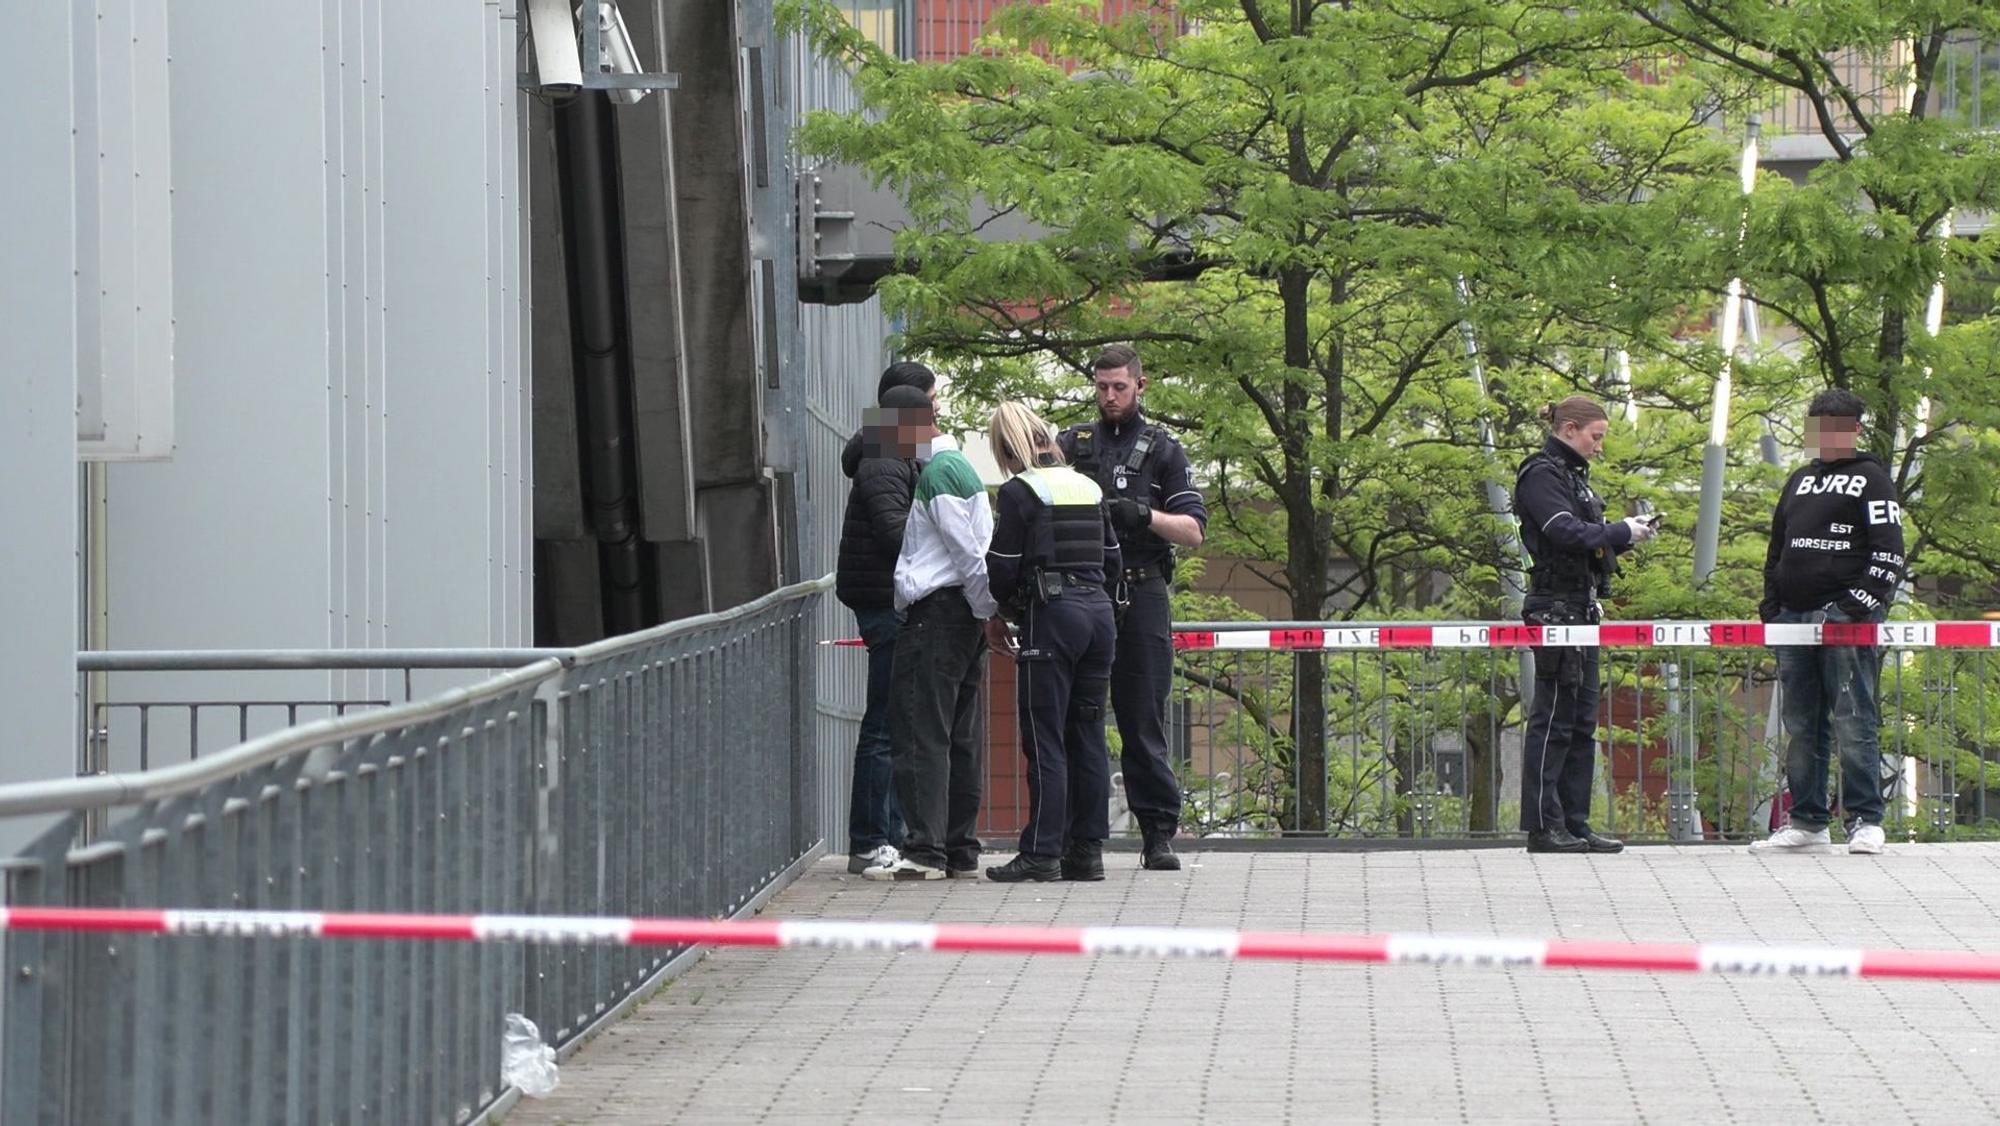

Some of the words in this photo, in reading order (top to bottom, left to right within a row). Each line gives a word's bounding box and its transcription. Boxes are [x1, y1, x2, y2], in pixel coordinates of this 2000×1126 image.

[1868, 500, 1902, 527] ER
[1830, 522, 1854, 535] EST
[1791, 537, 1851, 551] HORSEFER
